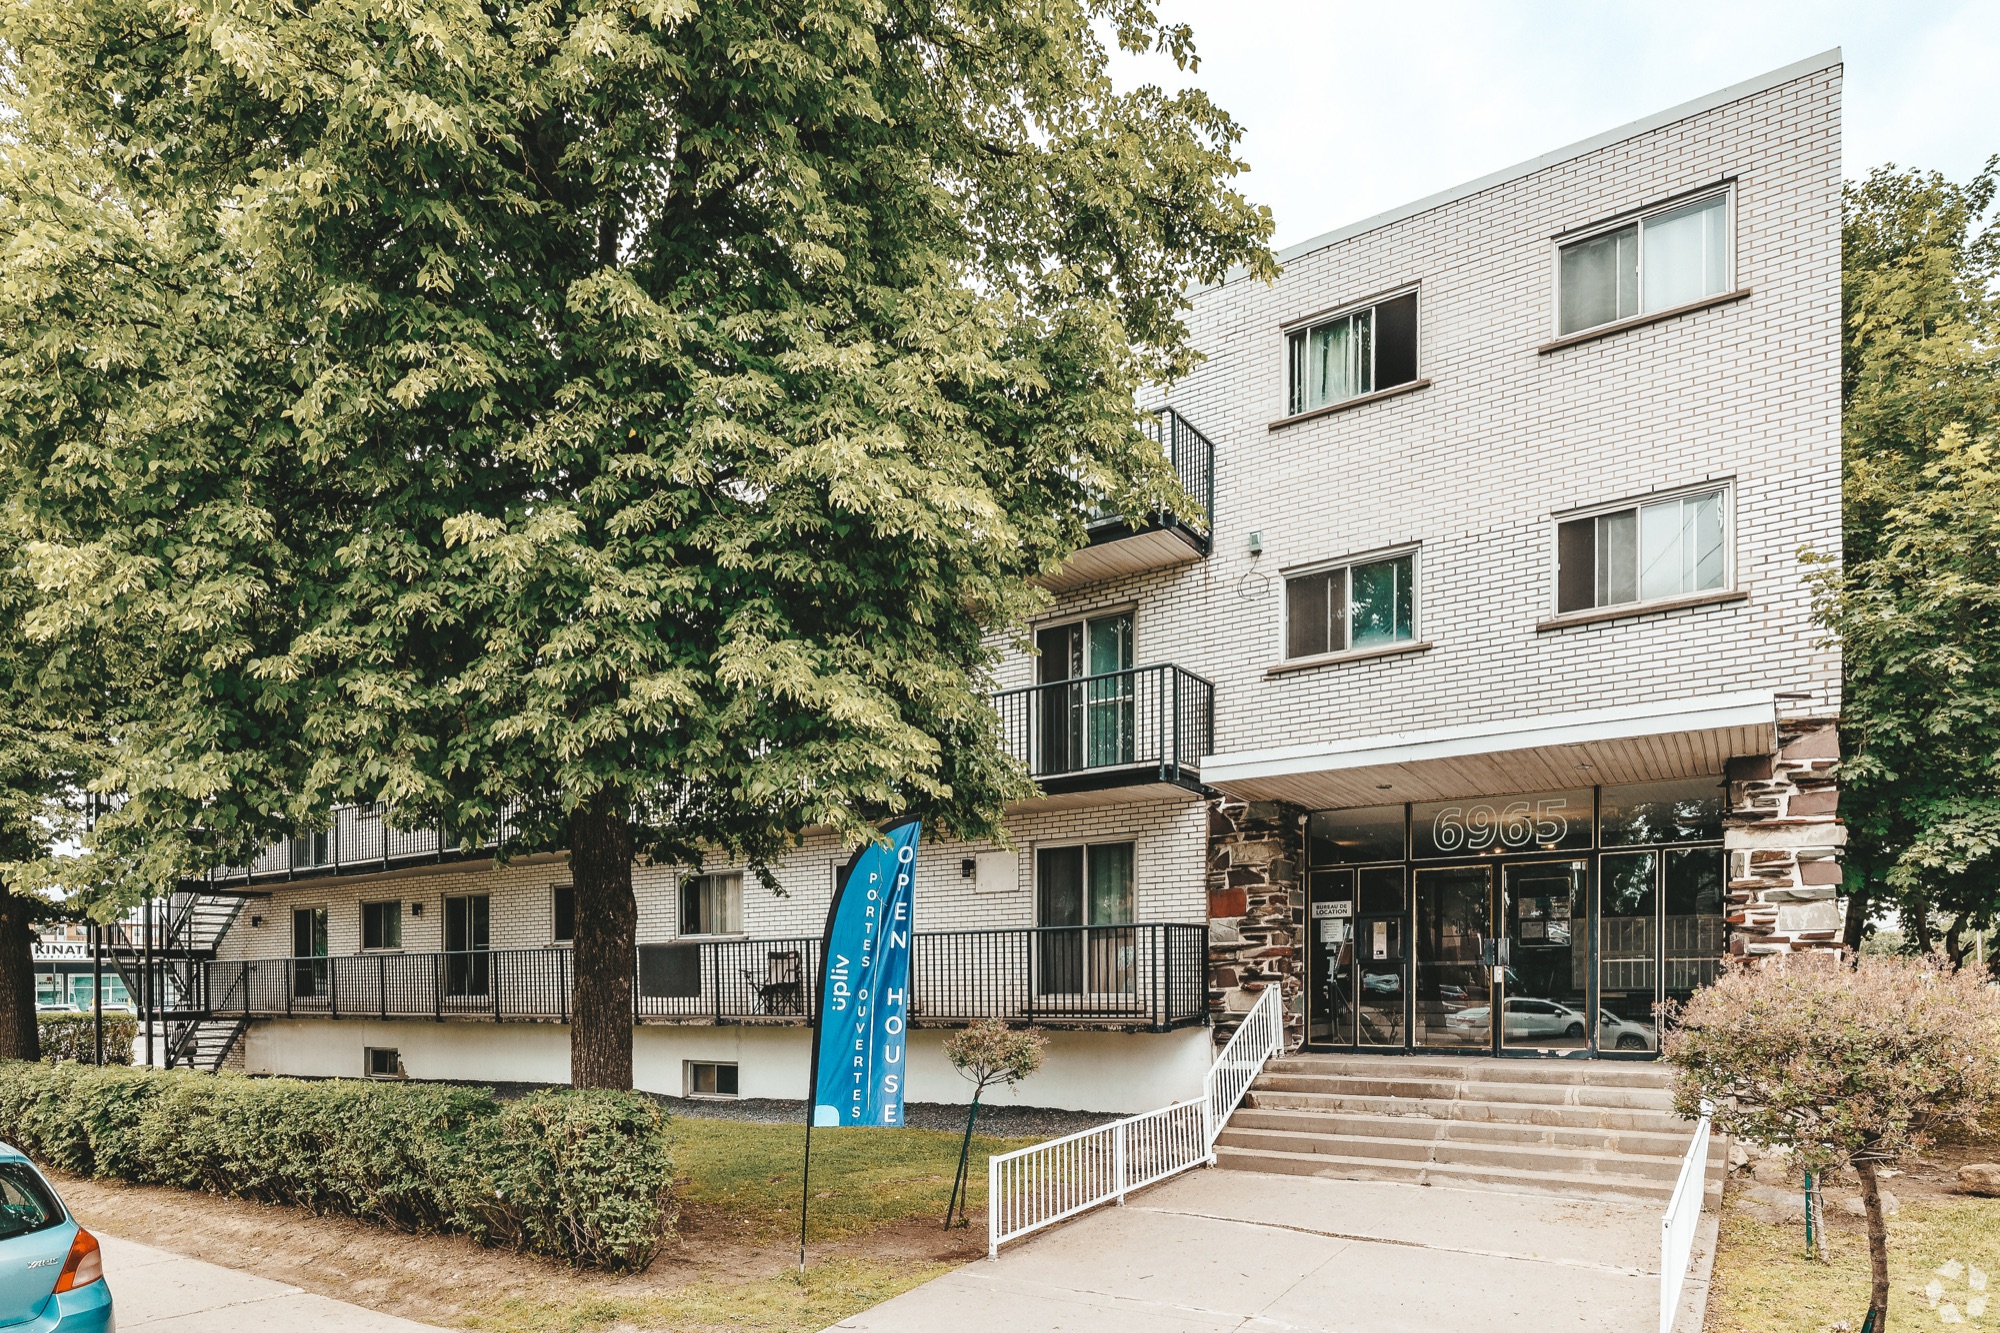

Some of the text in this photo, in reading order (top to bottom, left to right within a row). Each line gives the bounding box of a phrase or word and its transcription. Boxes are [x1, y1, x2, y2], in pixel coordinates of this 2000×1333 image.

[1433, 798, 1568, 851] 6965
[852, 872, 878, 1118] PORTES OUVERTES
[884, 846, 914, 1123] OPEN HOUSE
